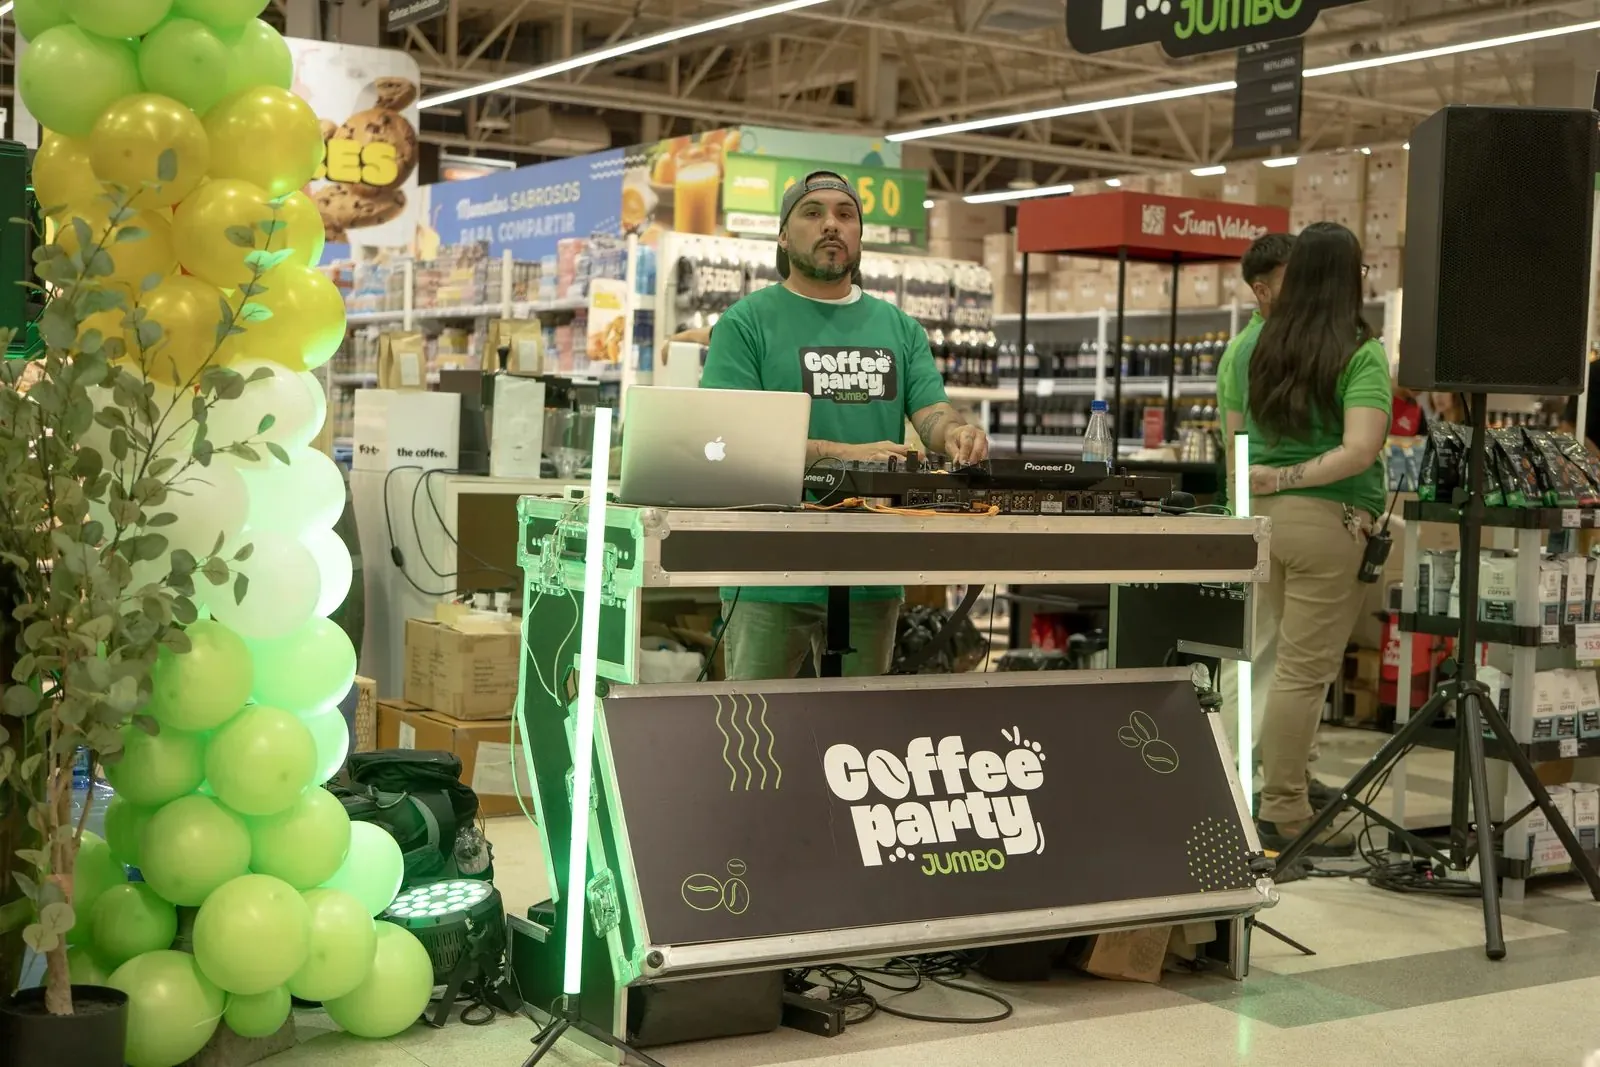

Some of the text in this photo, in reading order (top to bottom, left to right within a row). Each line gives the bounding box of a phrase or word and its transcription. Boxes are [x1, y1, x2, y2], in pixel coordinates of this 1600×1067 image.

[310, 139, 399, 186] ES
[510, 180, 580, 212] SABROSOS
[498, 211, 576, 242] COMPARTIR
[1172, 208, 1268, 240] Juan Valdez
[803, 350, 891, 374] Coffee
[812, 371, 886, 397] party
[835, 391, 869, 401] JUMBO
[397, 447, 447, 458] the coffee.
[1024, 462, 1063, 471] Pioneer
[823, 735, 1045, 801] Coffee
[850, 791, 1045, 867] party
[921, 848, 1006, 877] JUMBO
